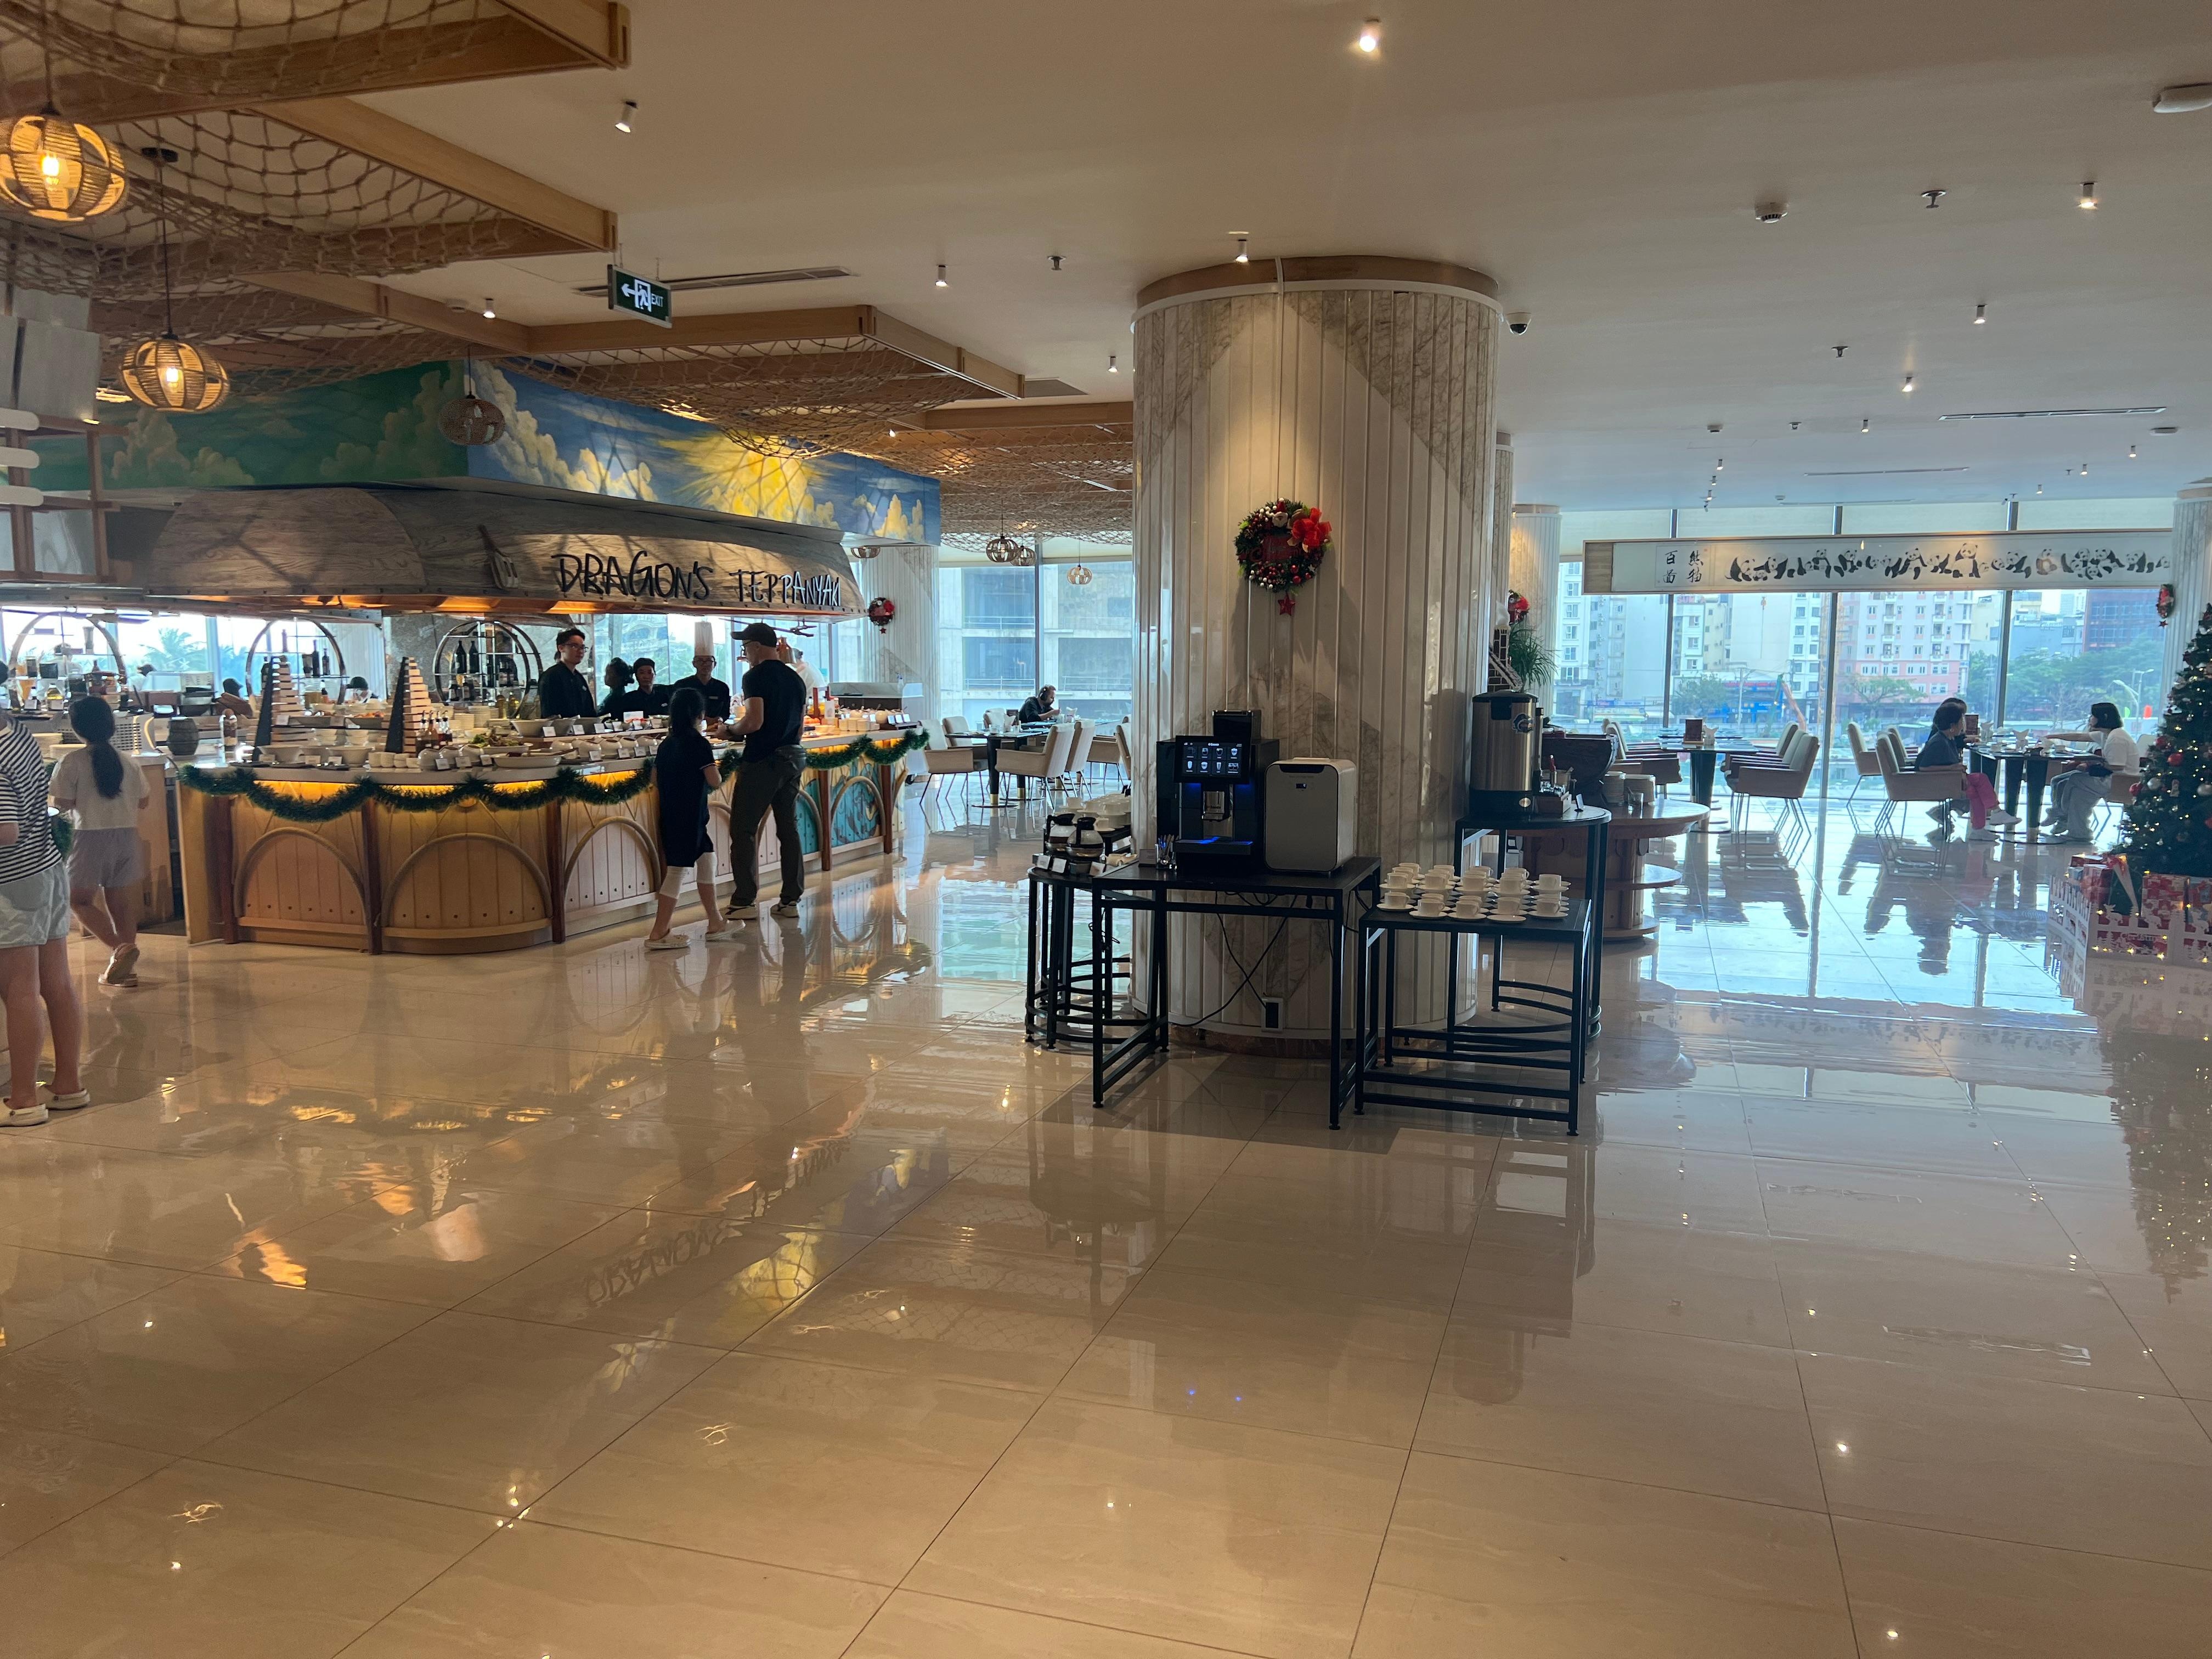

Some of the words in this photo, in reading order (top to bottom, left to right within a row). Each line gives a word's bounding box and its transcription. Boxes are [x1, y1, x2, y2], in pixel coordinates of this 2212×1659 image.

[651, 293, 664, 308] EXIT
[551, 550, 714, 600] DRAGON'S
[729, 569, 841, 606] TEPPANYAKI
